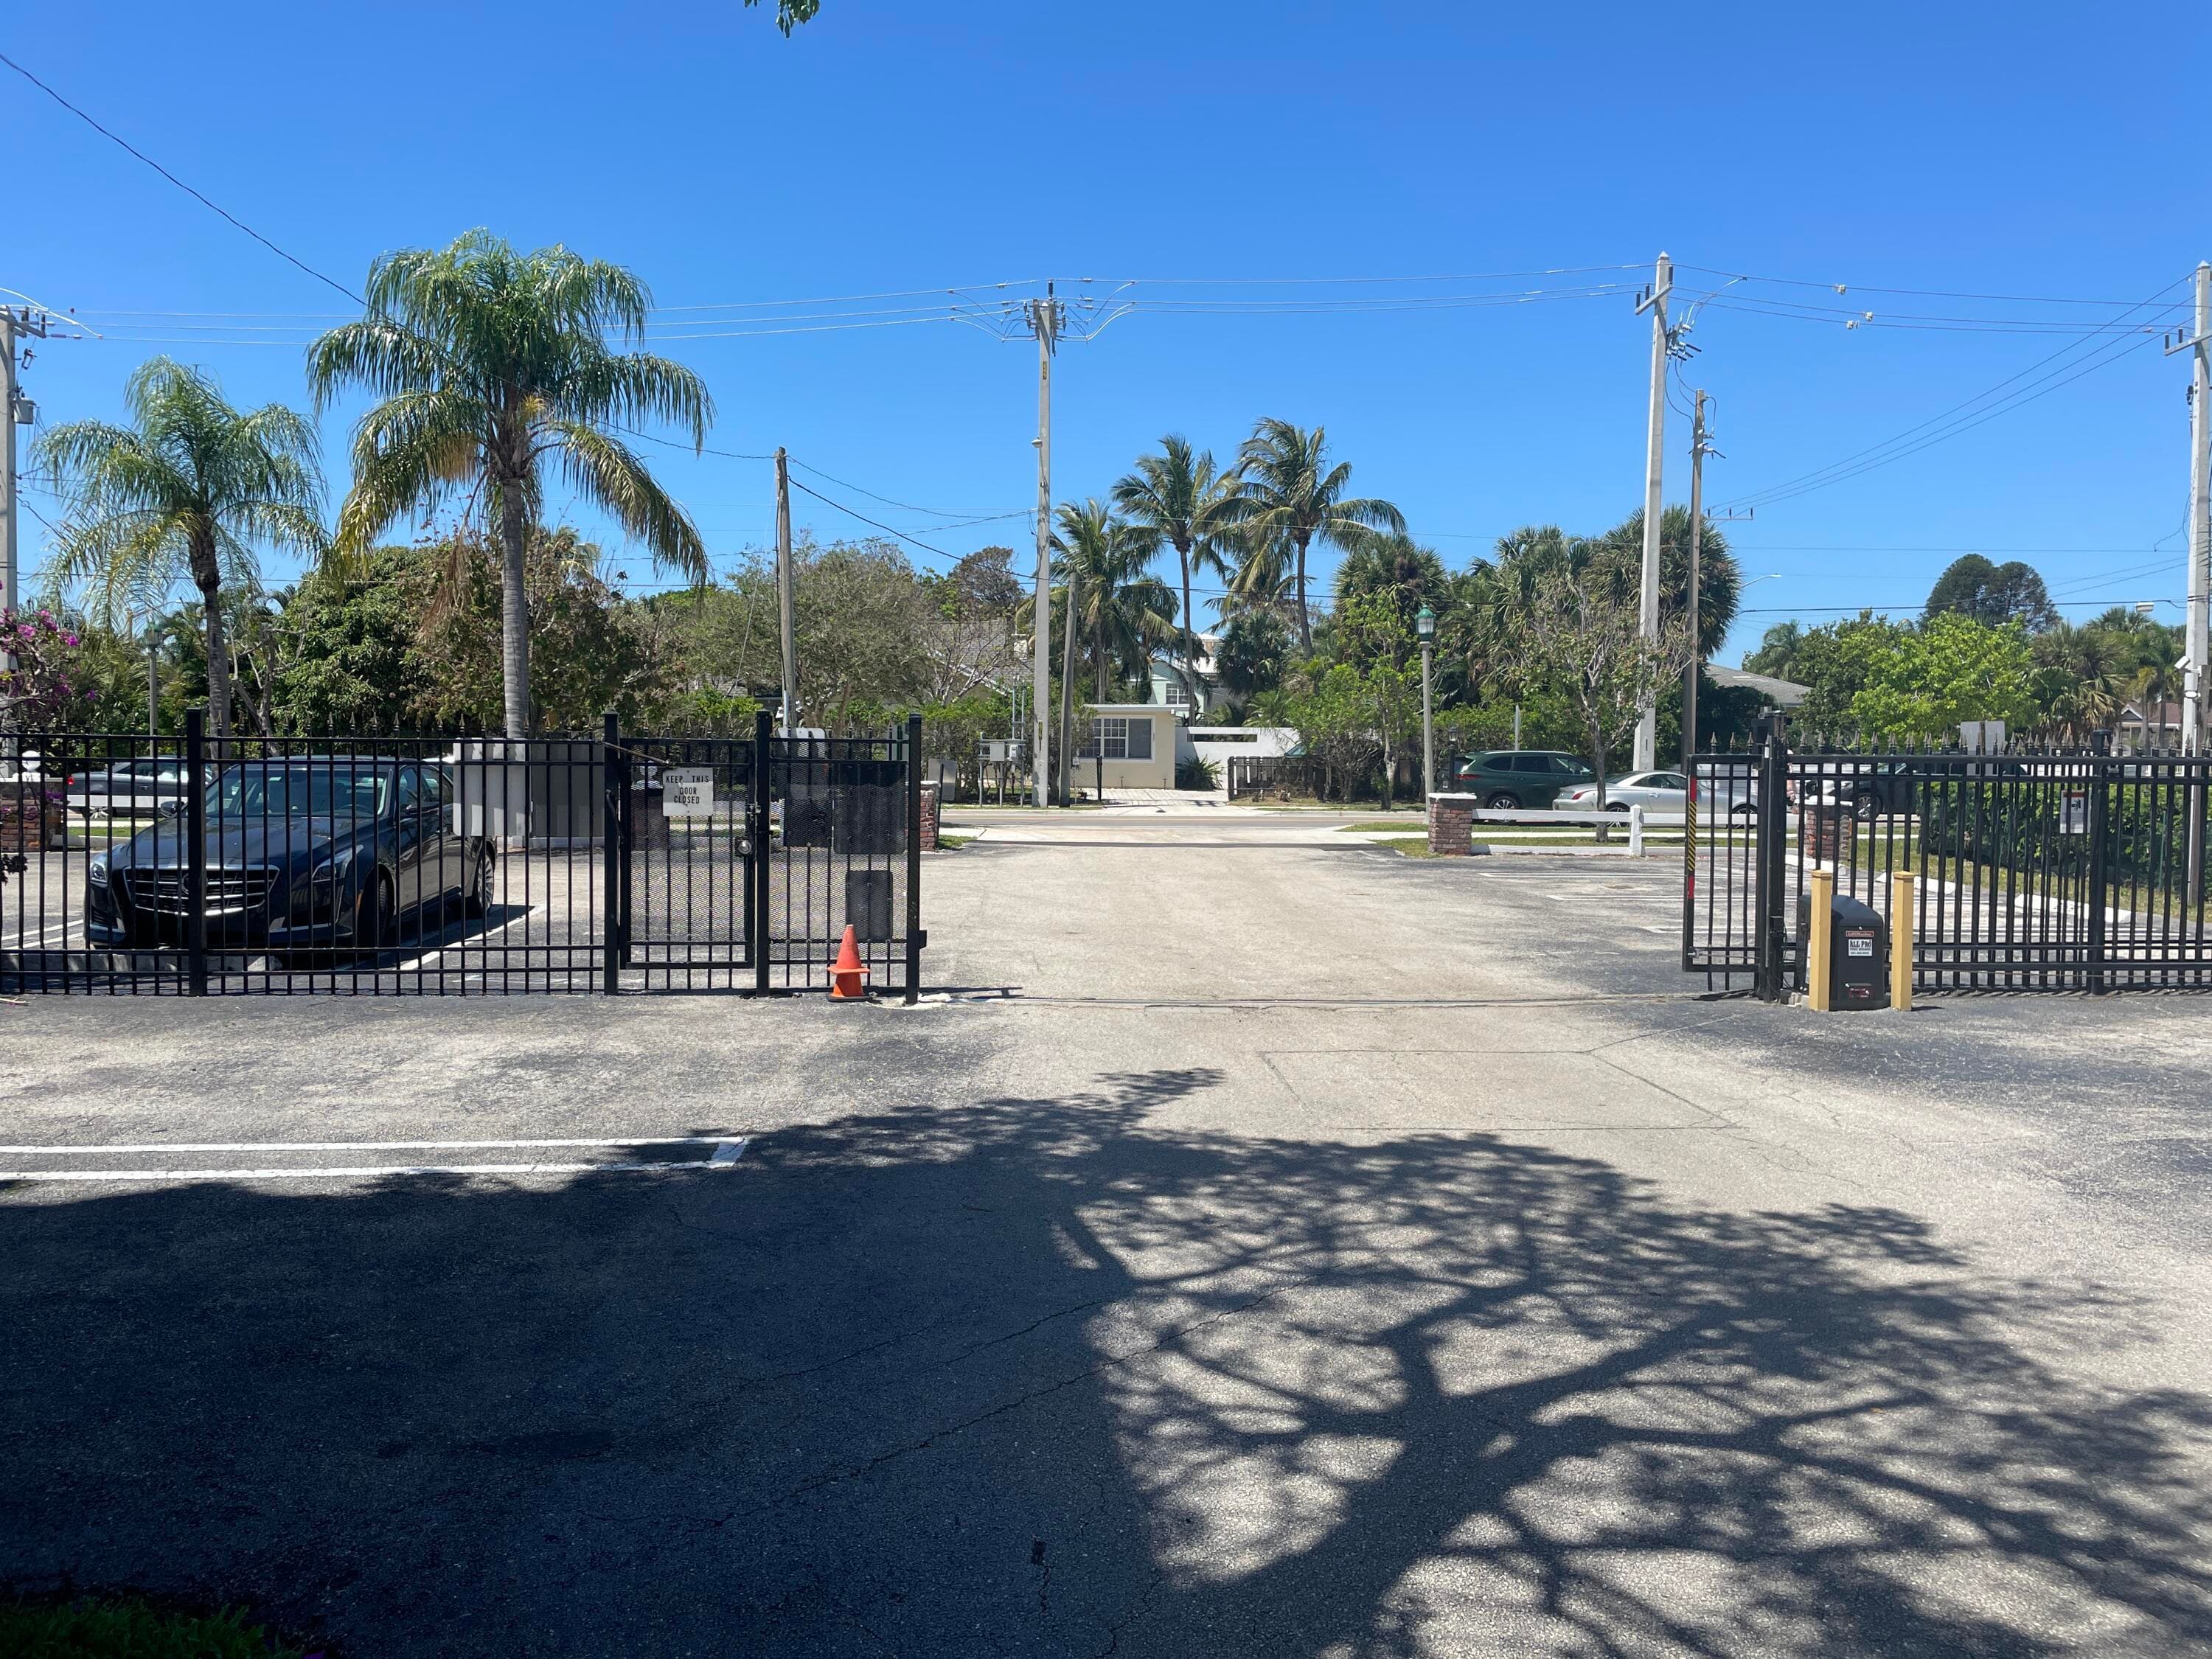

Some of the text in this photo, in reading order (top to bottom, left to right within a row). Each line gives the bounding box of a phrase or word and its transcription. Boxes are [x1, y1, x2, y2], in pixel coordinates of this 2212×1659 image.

[666, 775, 709, 783] KEEP THIS
[679, 787, 697, 795] DOOR
[674, 796, 700, 804] CLOSED
